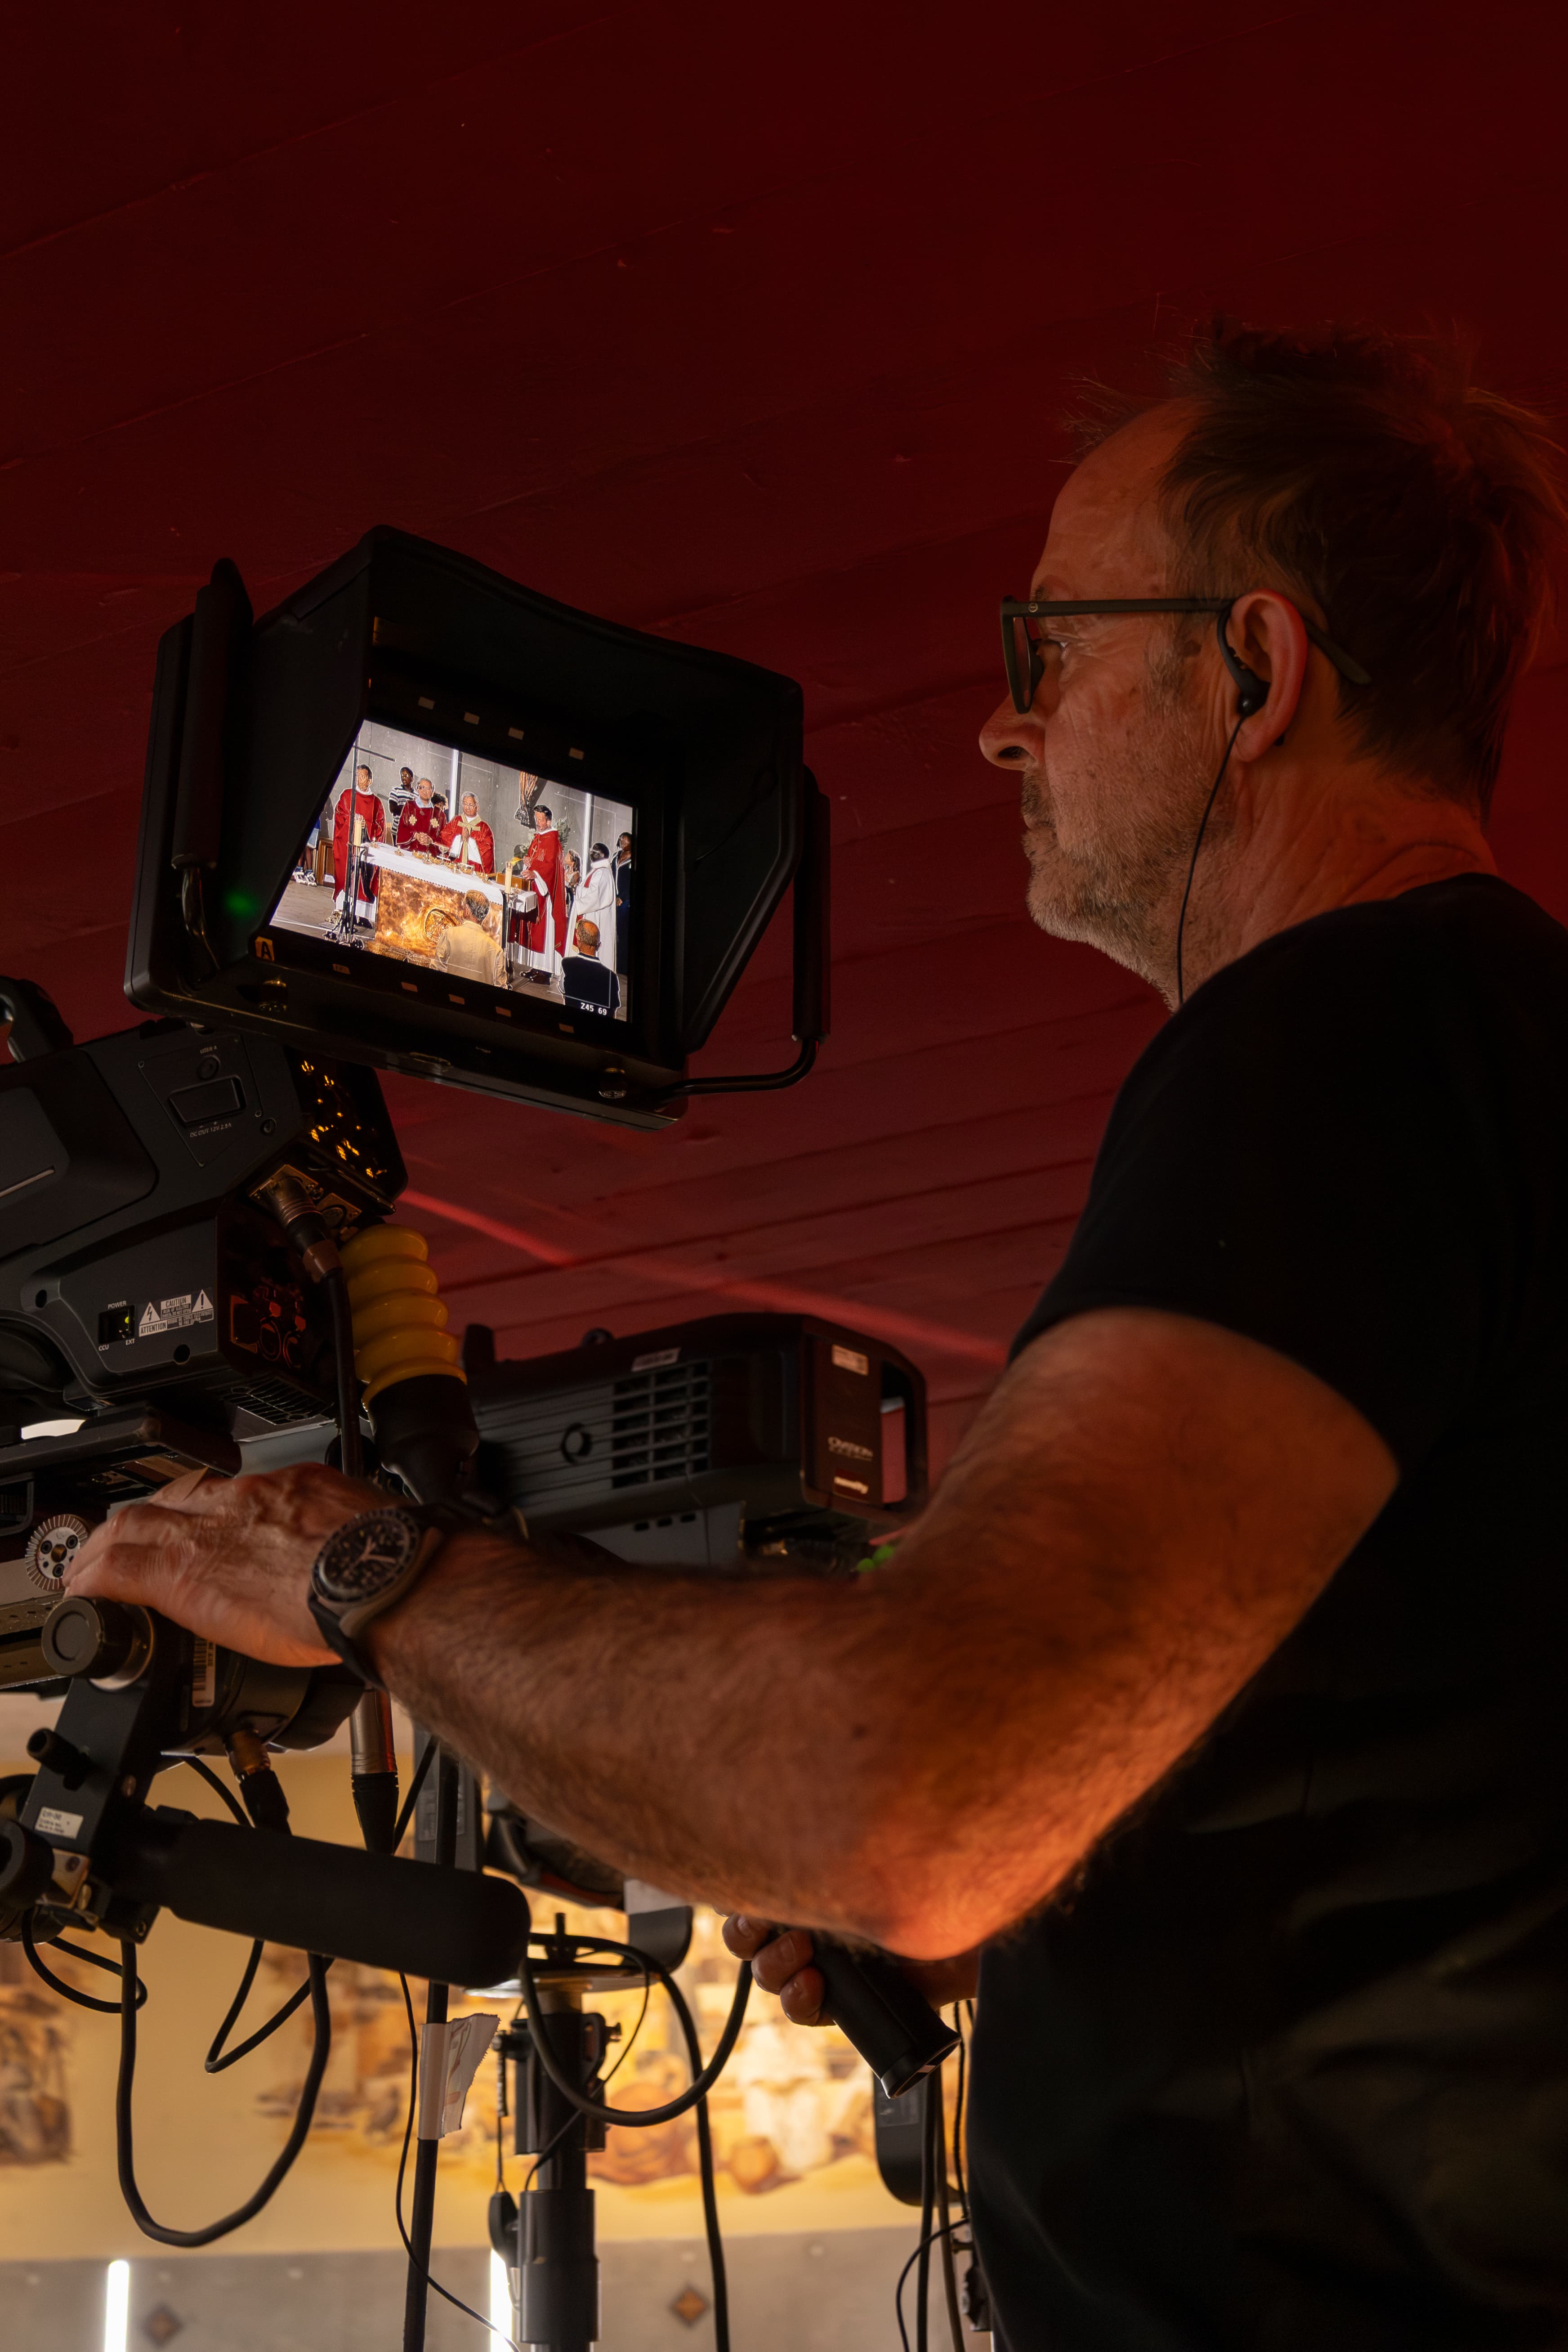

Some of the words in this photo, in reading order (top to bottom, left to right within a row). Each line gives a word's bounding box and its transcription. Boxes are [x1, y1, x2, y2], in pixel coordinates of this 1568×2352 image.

[261, 941, 272, 959] A
[581, 1002, 594, 1012] Z45
[598, 1007, 607, 1015] 69
[198, 1127, 209, 1136] OUT
[107, 1301, 126, 1310] POWER
[165, 1297, 186, 1308] CAUTION
[140, 1322, 166, 1334] ATTENTION
